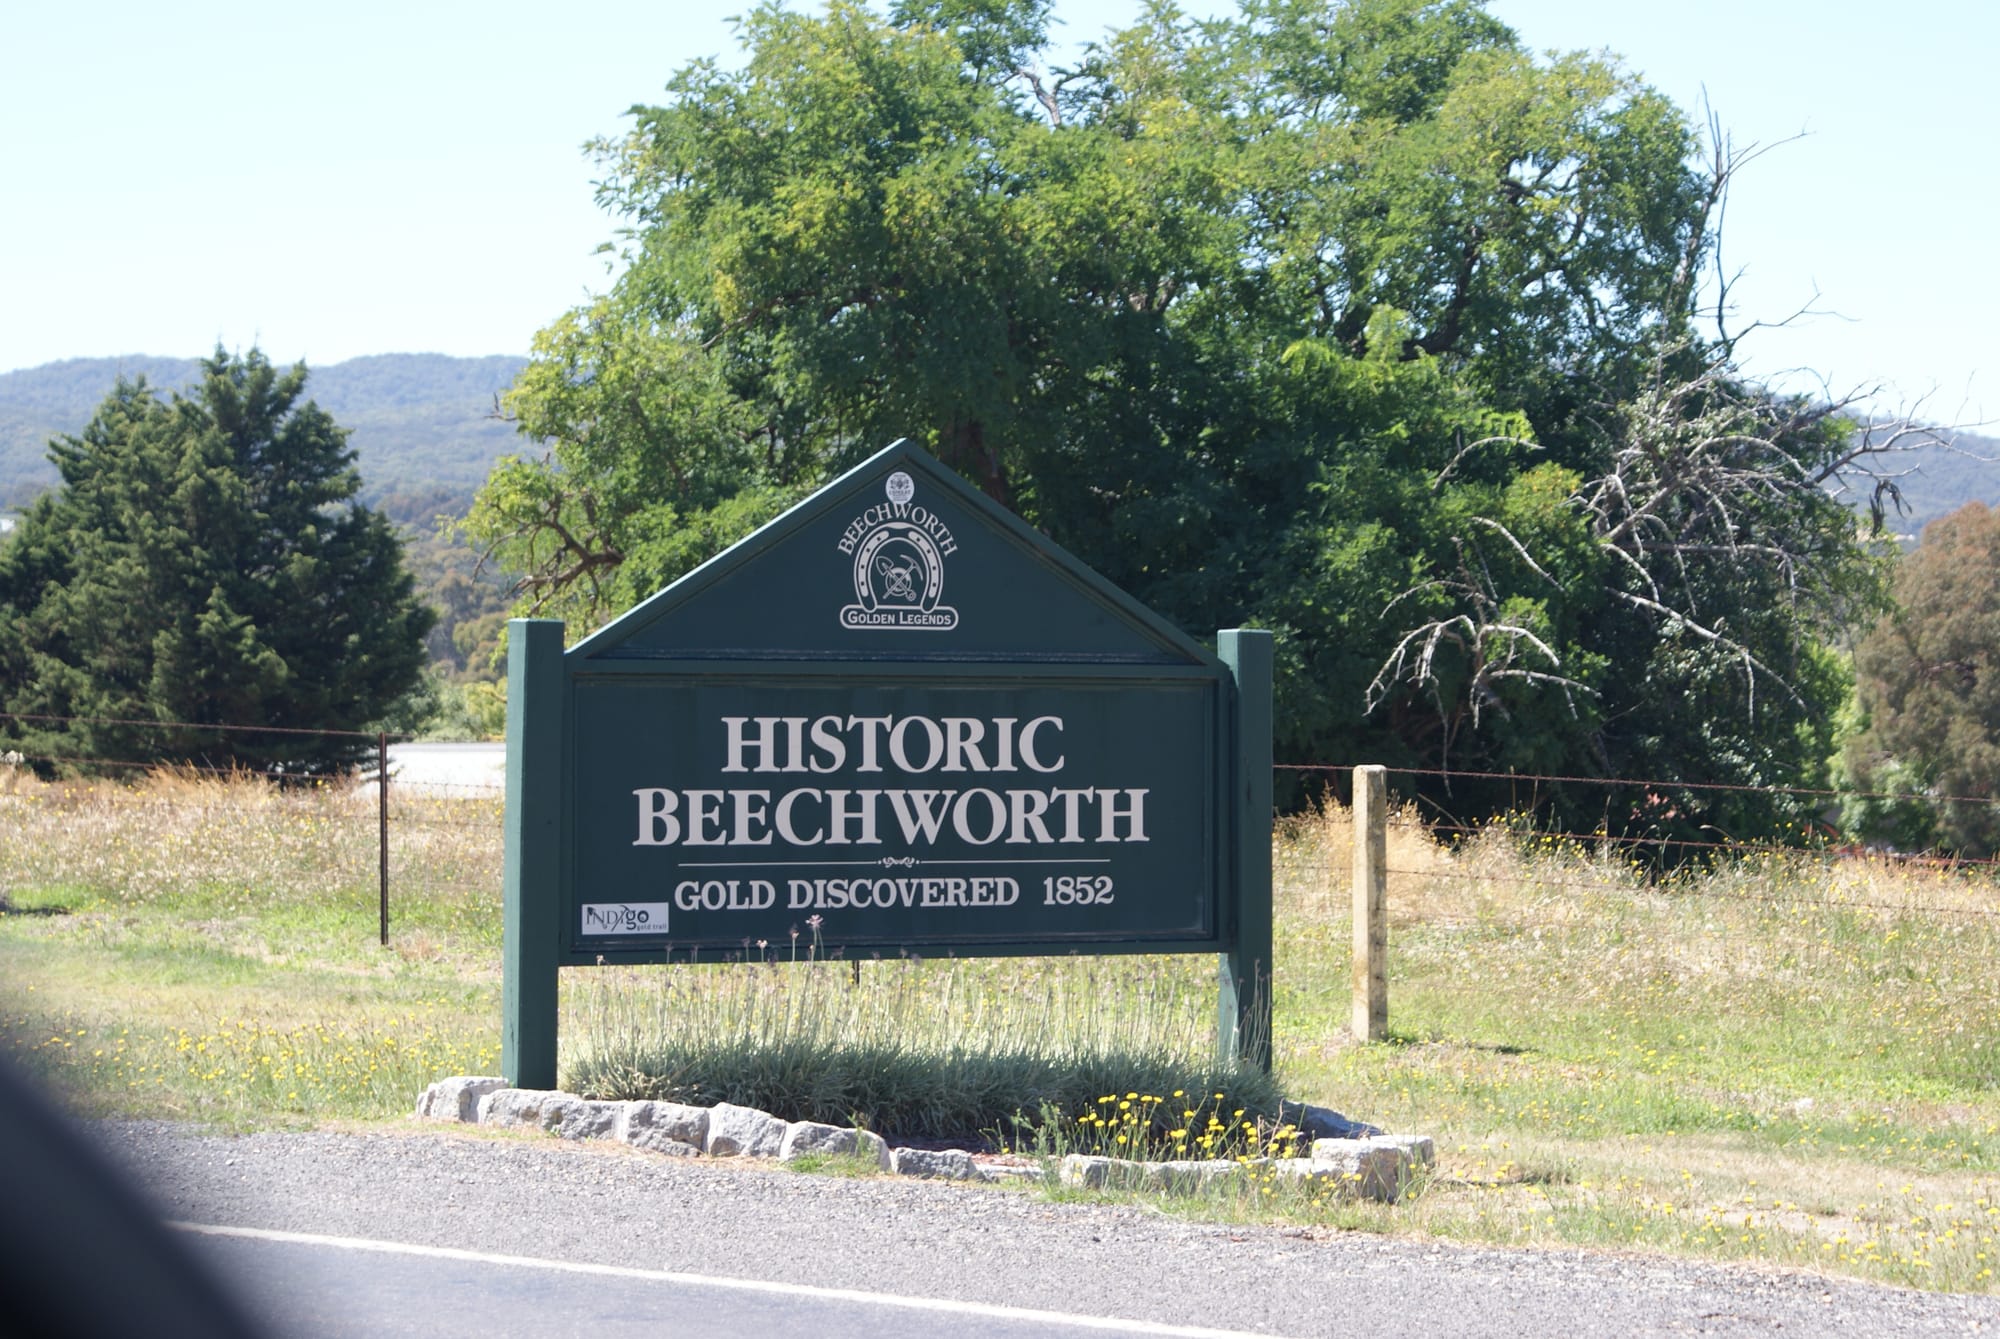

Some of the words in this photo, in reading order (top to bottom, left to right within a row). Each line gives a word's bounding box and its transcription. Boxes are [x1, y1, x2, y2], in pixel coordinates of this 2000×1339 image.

[837, 502, 958, 557] BEECHWORTH
[721, 714, 1065, 773] HISTORIC
[632, 786, 1150, 846] BEECHWORTH
[674, 881, 775, 911] GOLD
[788, 877, 1020, 909] DISCOVERED
[1043, 876, 1115, 905] 1852
